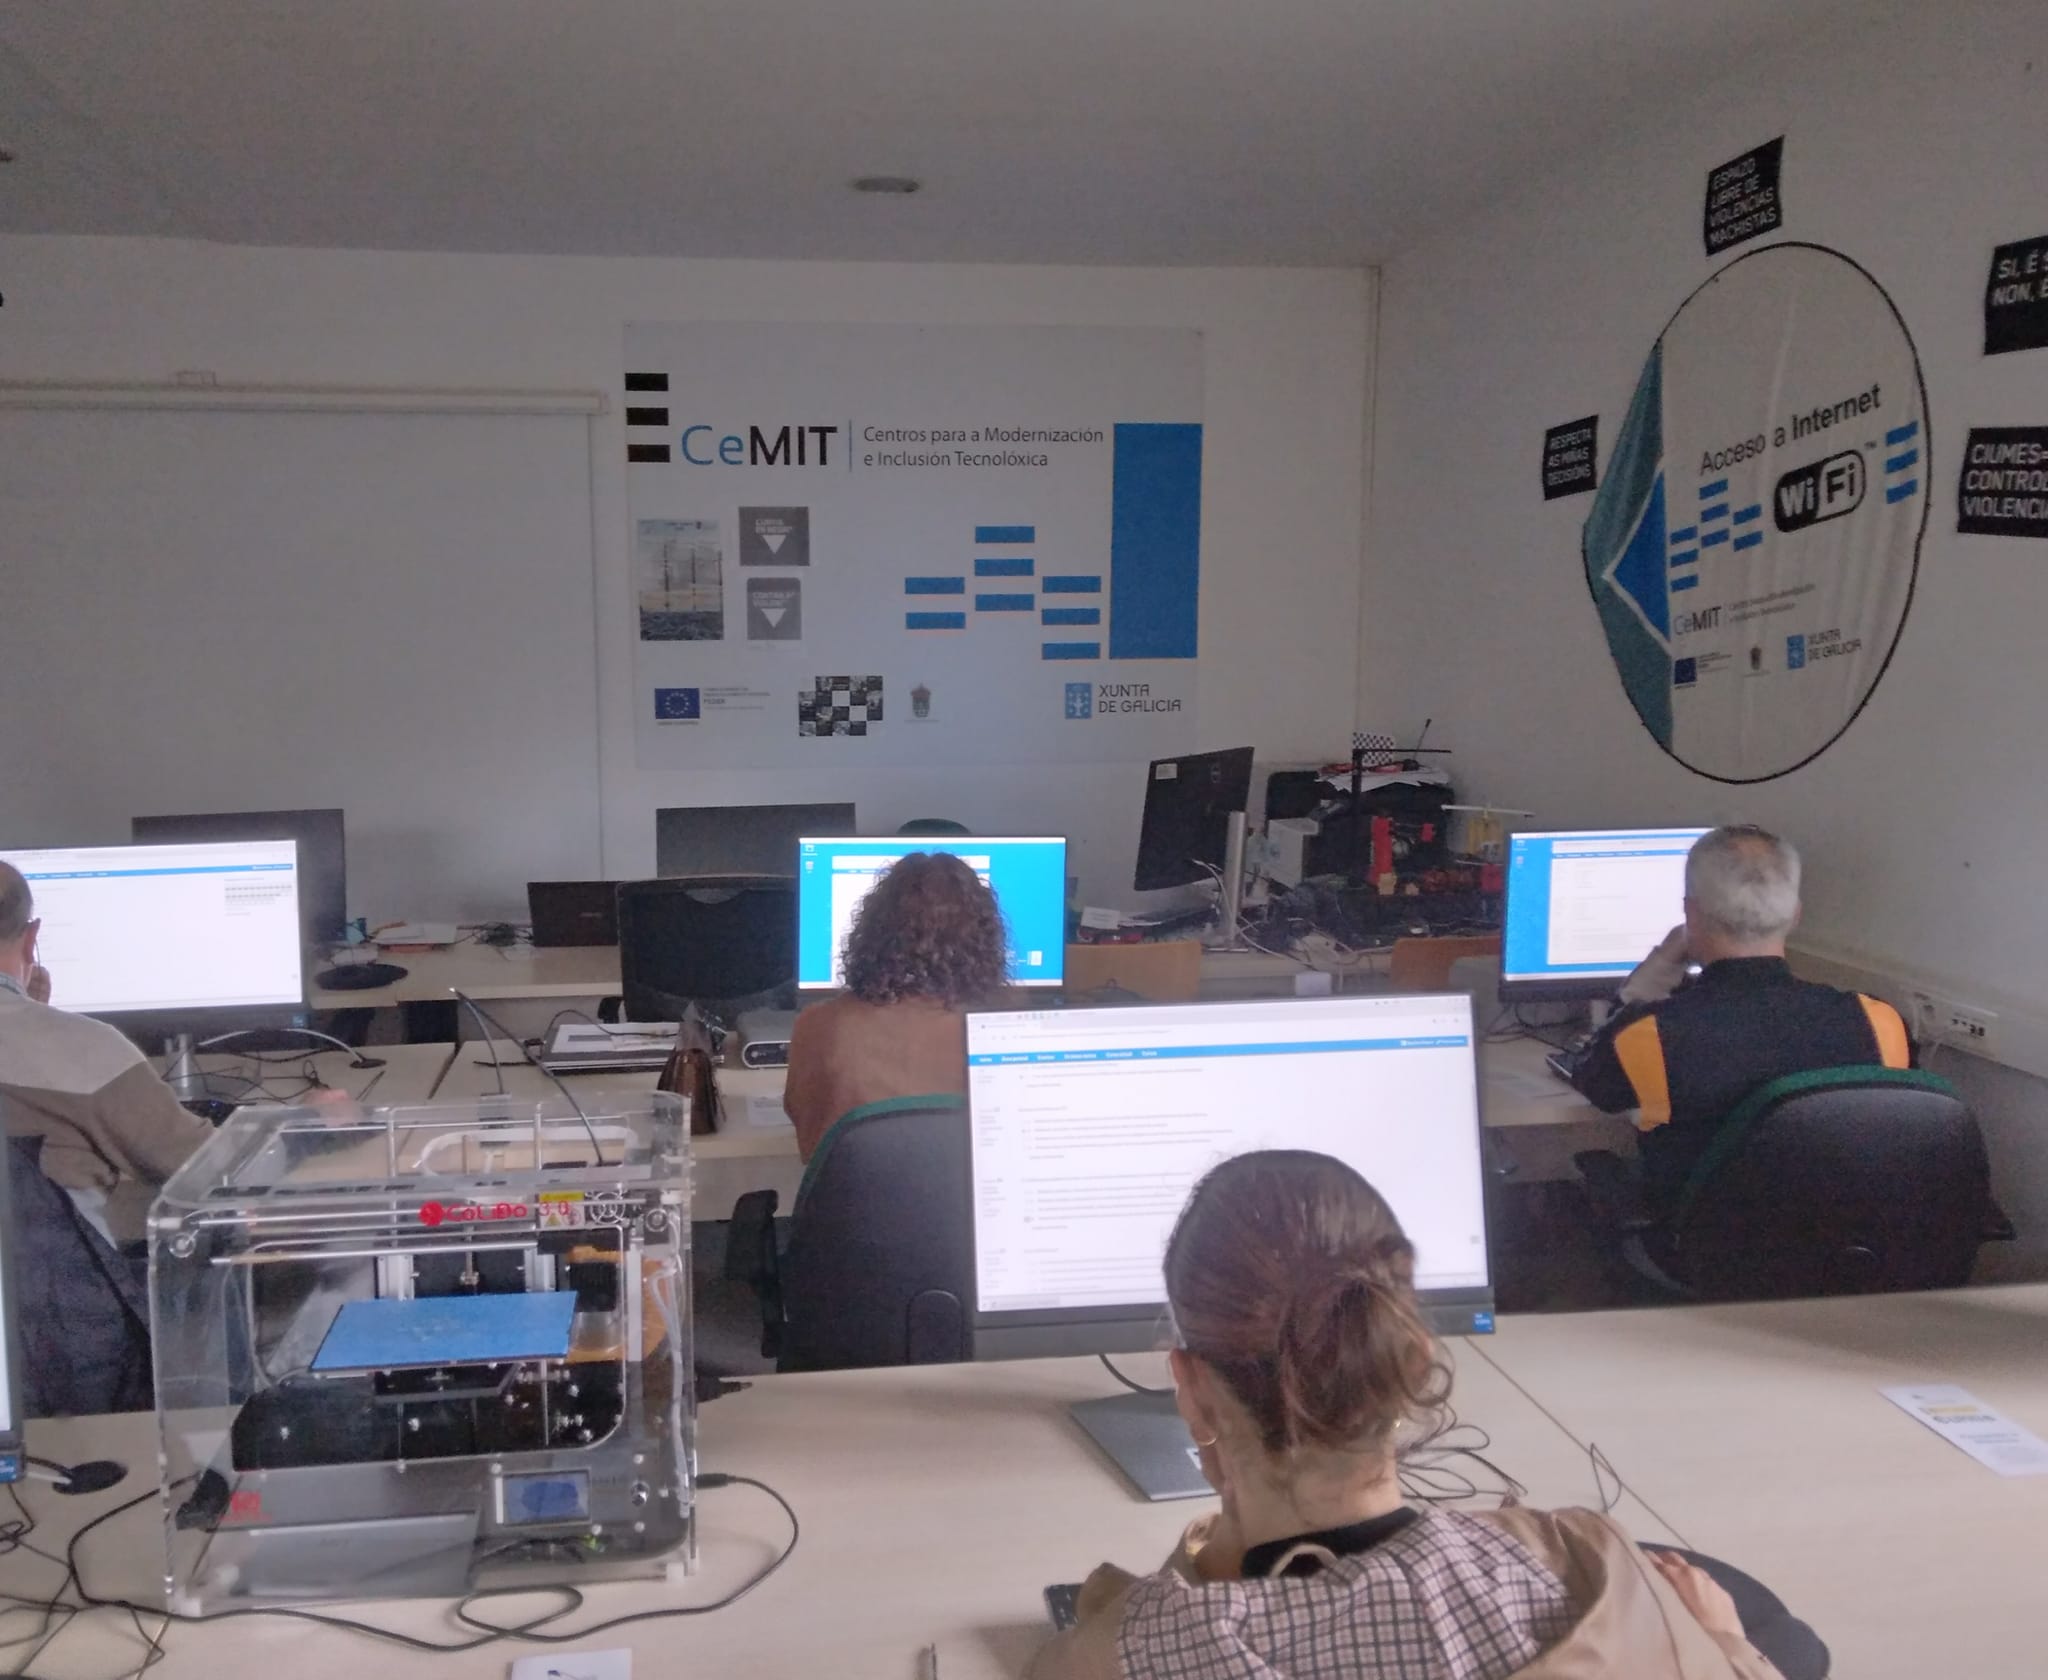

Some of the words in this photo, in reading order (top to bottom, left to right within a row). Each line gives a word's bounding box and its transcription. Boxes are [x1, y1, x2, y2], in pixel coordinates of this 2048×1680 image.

[1744, 174, 1760, 194] DE
[1710, 207, 1777, 244] MACHISTAS
[864, 426, 927, 443] Centros
[931, 430, 966, 446] para
[970, 429, 980, 442] a
[984, 425, 1104, 443] Modernización
[1699, 433, 1767, 477] Acceso
[1773, 425, 1786, 448] a
[1793, 383, 1881, 440] Internet
[681, 424, 838, 466] CeMIT
[864, 453, 873, 467] e
[877, 450, 951, 467] Inclusión
[955, 450, 1049, 467] Tecnolóxica
[1673, 606, 1722, 636] CeMIT
[1099, 684, 1150, 698] XUNTA
[1098, 700, 1118, 713] DE
[1120, 699, 1182, 713] GALICIA
